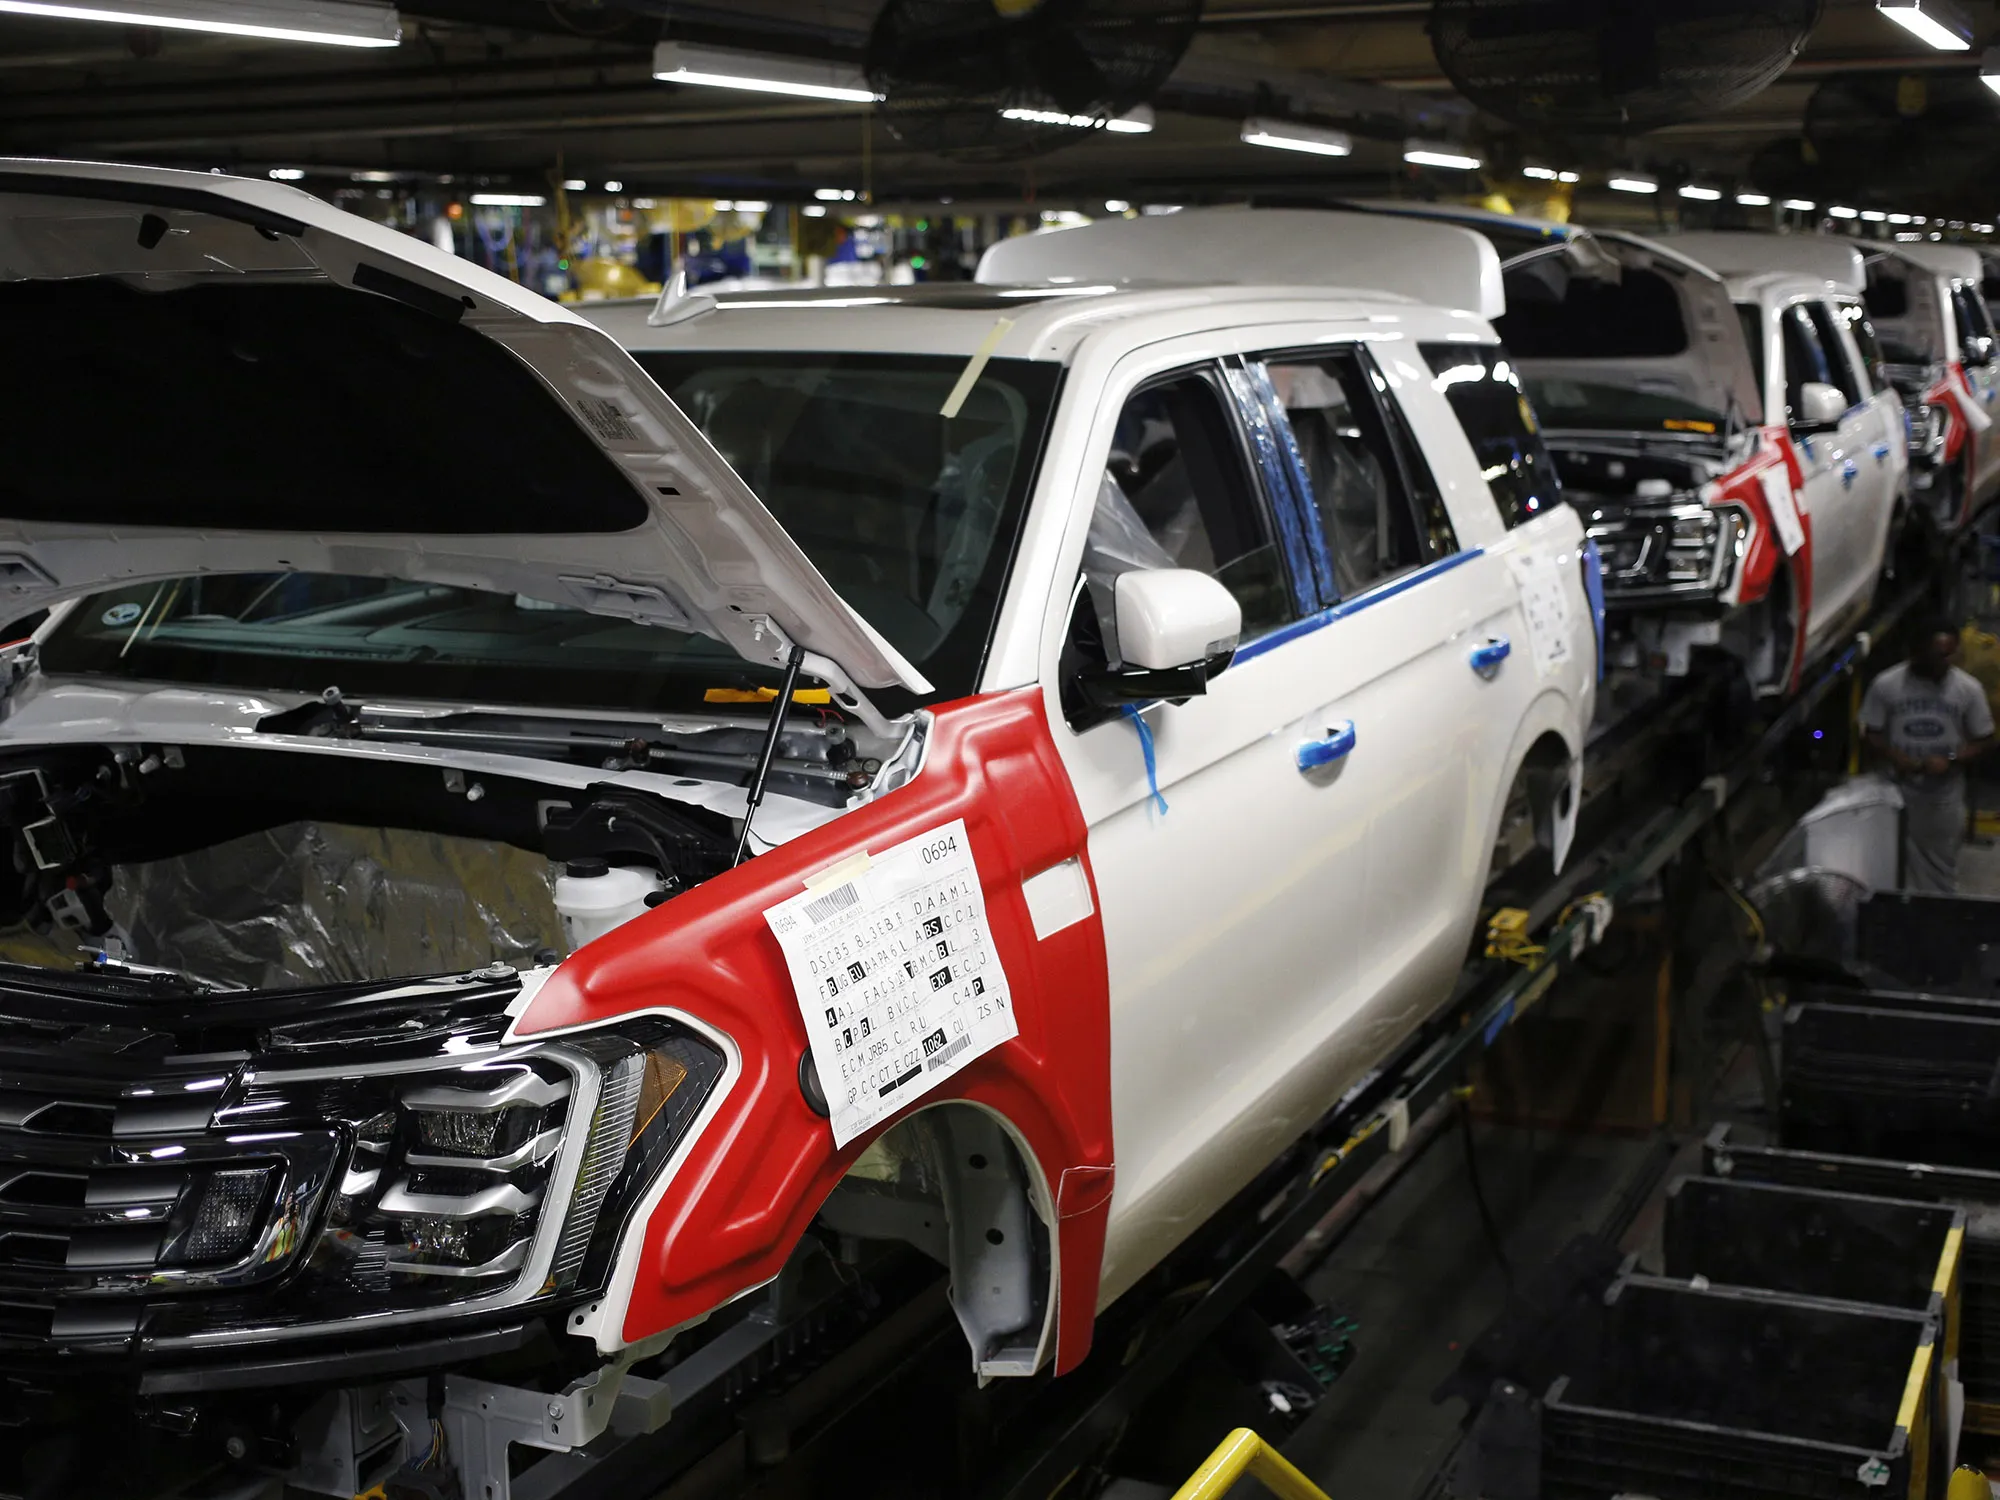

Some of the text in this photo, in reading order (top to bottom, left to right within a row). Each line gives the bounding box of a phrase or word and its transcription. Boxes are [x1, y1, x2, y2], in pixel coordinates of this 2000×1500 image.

[922, 836, 957, 864] 0694
[774, 915, 797, 934] 0694
[932, 971, 947, 991] EXP
